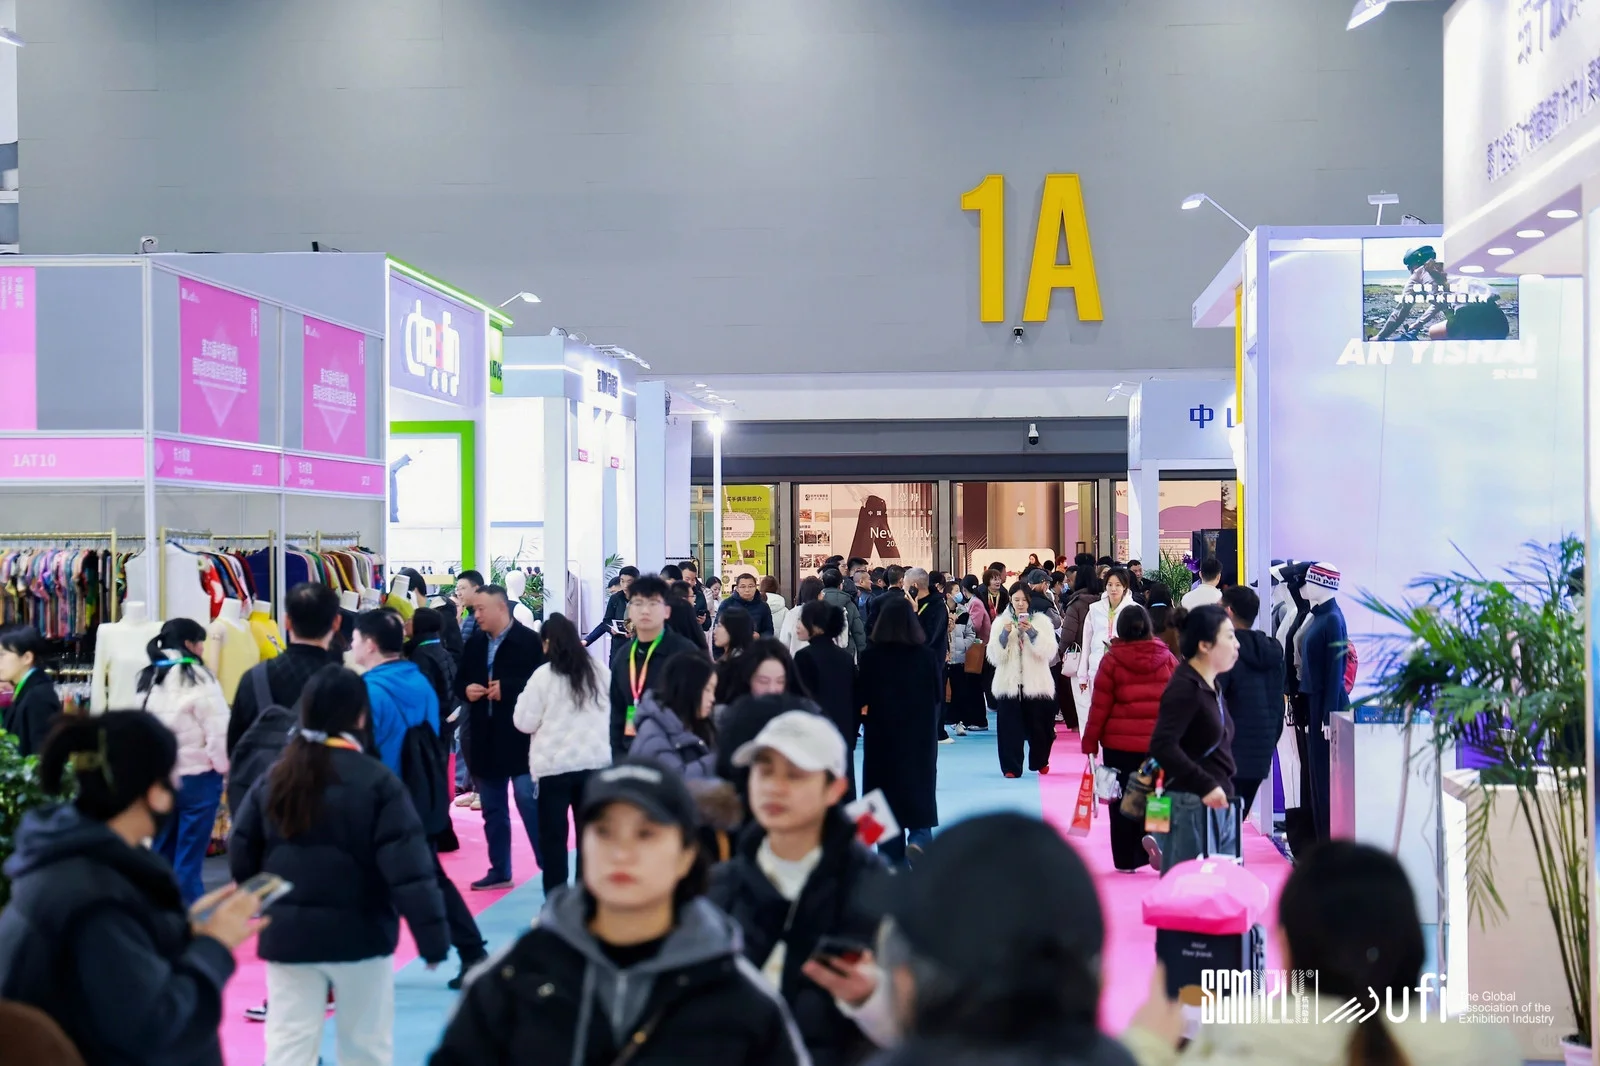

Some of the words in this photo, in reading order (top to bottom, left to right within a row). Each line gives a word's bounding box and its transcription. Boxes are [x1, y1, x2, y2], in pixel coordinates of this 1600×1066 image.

[961, 173, 1104, 322] 1A
[1336, 338, 1397, 366] AN
[12, 454, 57, 468] 1AT10
